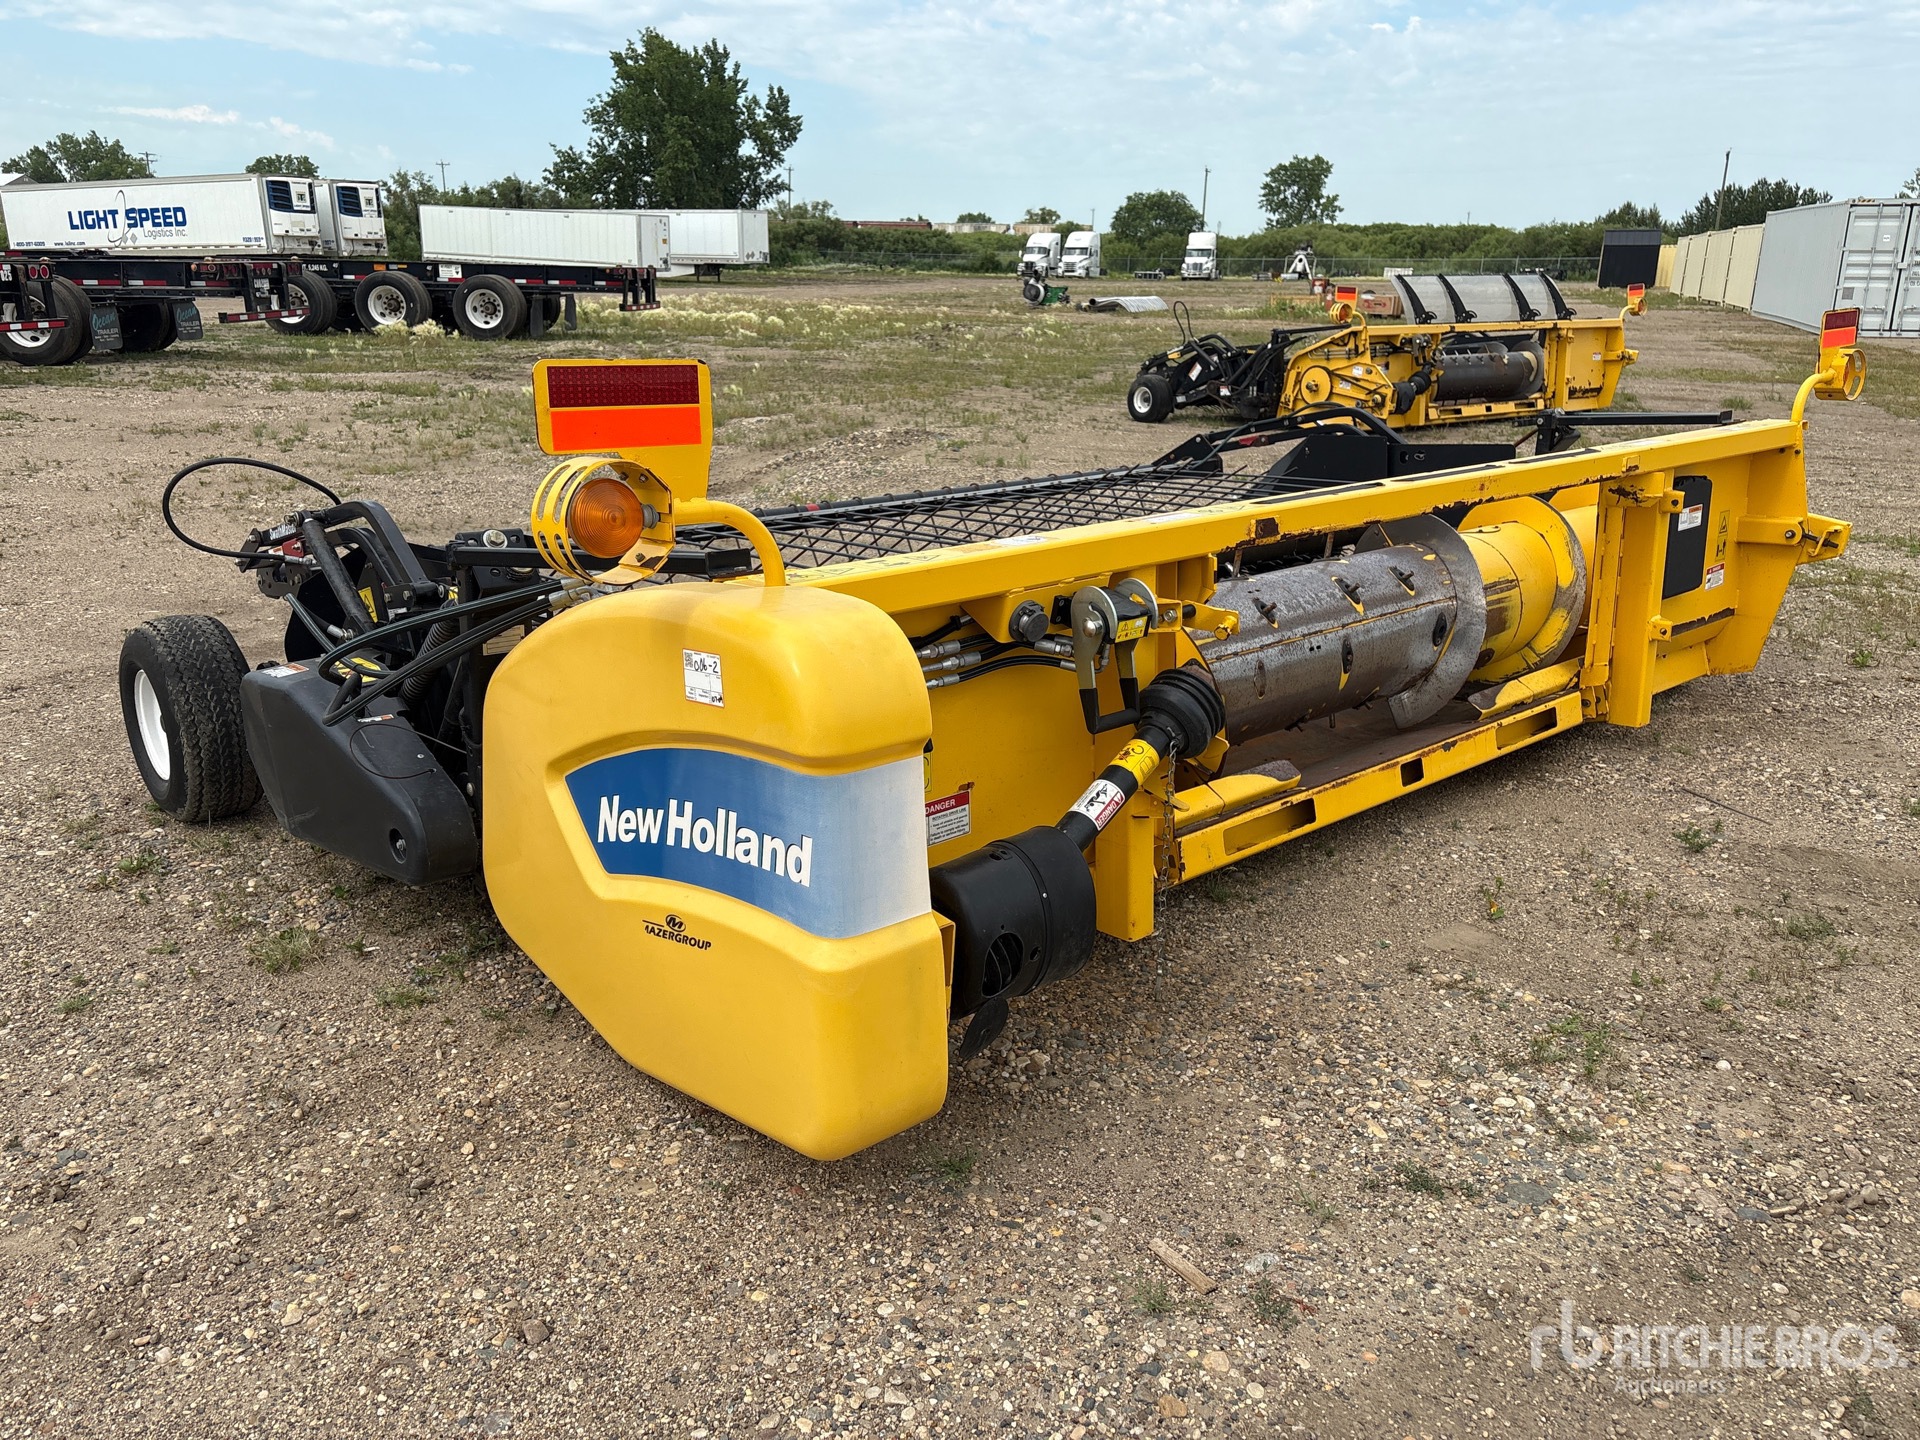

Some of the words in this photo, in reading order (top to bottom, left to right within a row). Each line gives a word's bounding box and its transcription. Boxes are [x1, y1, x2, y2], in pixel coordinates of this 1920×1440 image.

[67, 209, 119, 230] LIGHT
[124, 206, 187, 229] SPEED
[143, 228, 174, 240] Logistics
[174, 227, 188, 237] Inc.
[92, 311, 116, 331] Ocean
[176, 306, 197, 323] Ocean
[925, 798, 956, 815] DANGER
[1096, 800, 1118, 827] DANGER
[597, 794, 664, 845] New
[666, 798, 813, 888] Holland
